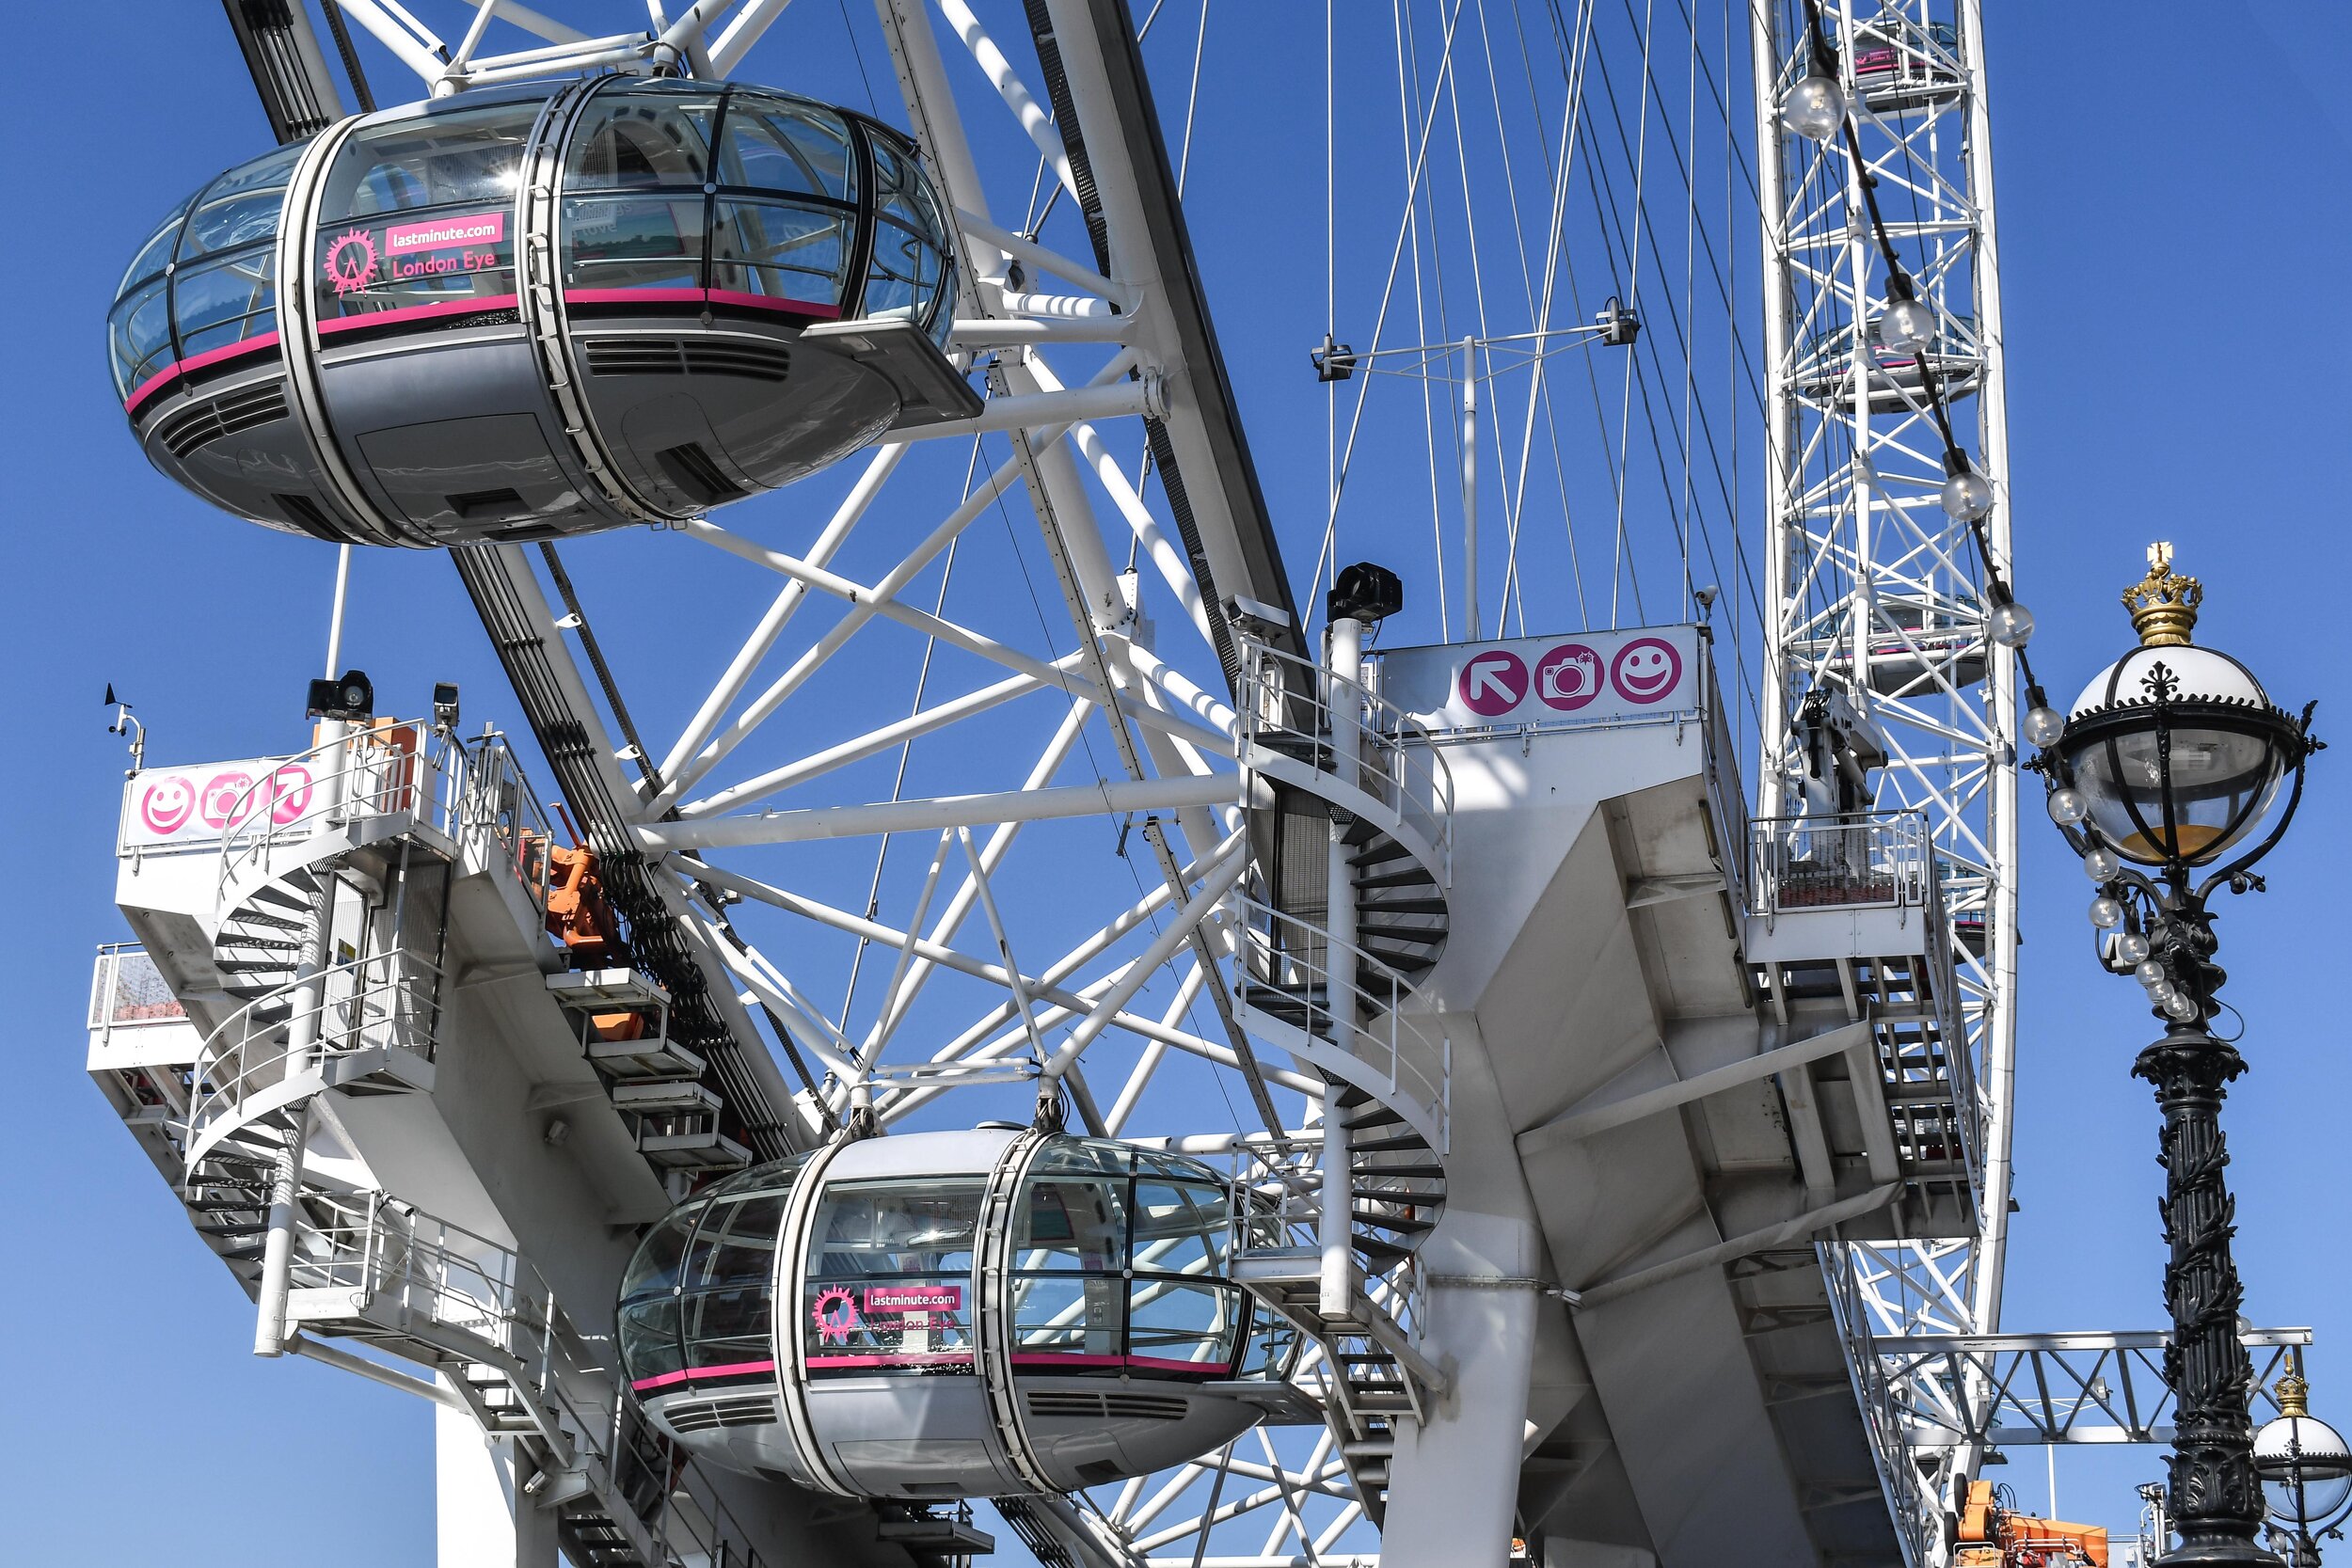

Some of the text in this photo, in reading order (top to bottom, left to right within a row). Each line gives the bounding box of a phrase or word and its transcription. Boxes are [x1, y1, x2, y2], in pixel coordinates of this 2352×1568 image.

[393, 225, 495, 247] lastminute.com
[392, 250, 495, 277] London Eye
[870, 1294, 955, 1307] lastminute.com
[870, 1315, 955, 1332] London Eye
